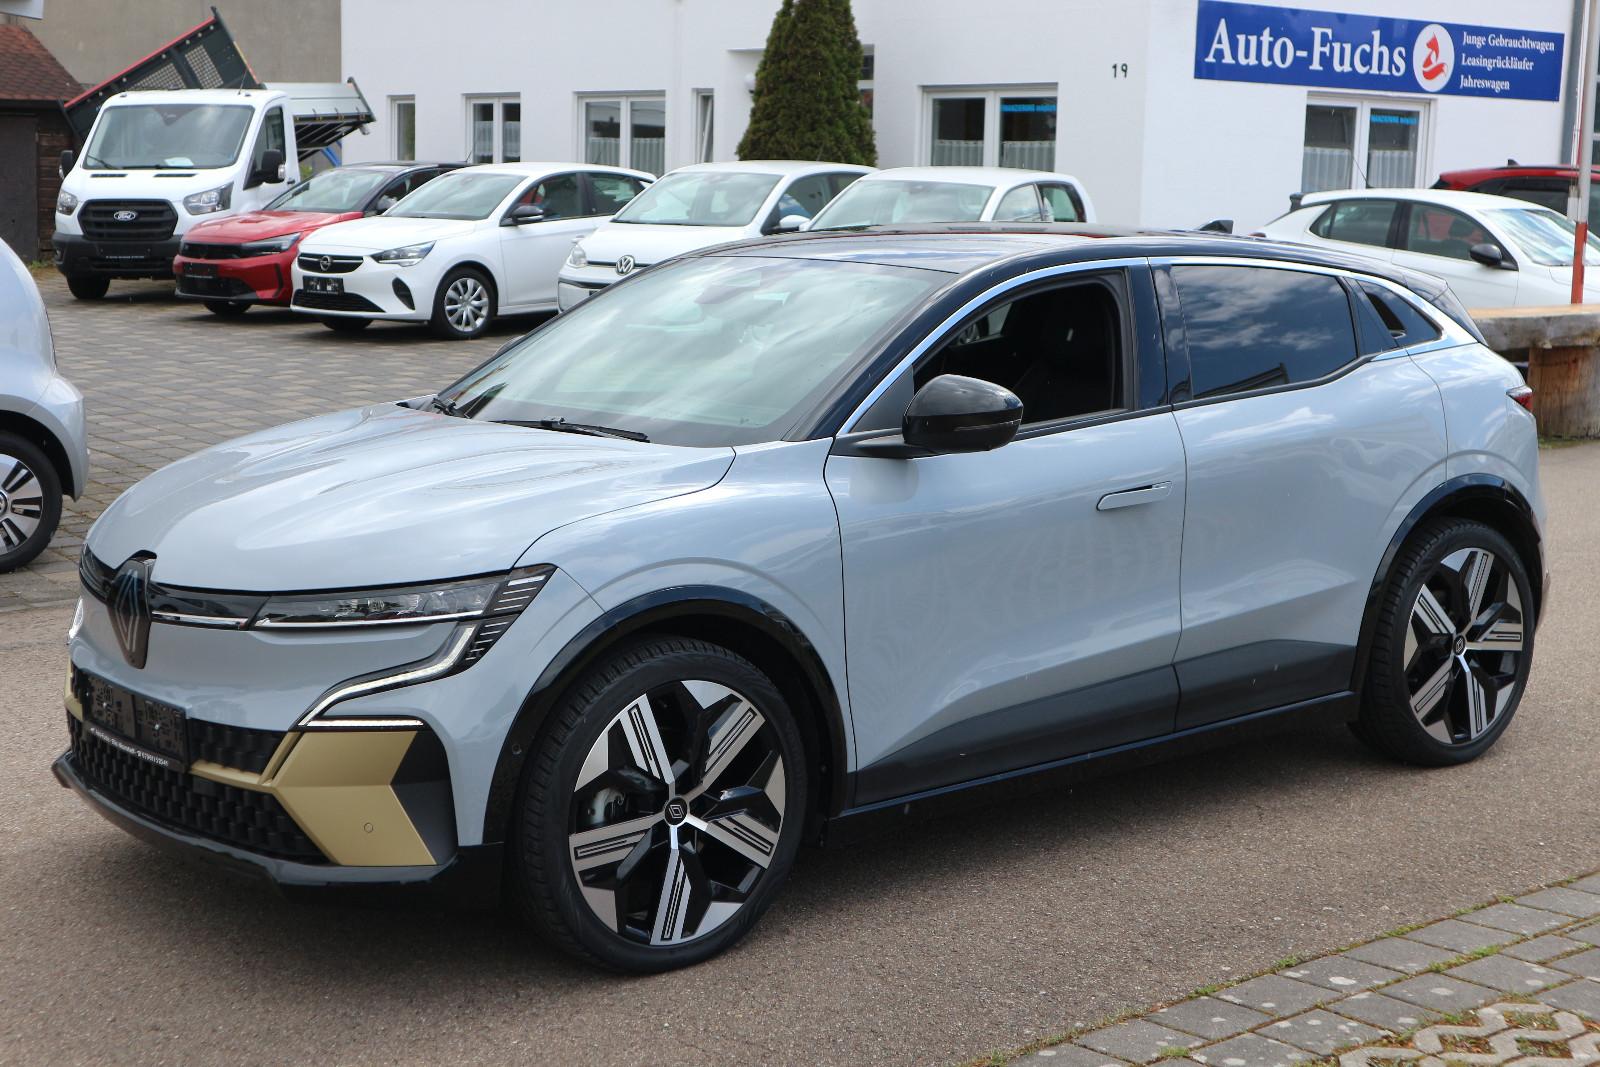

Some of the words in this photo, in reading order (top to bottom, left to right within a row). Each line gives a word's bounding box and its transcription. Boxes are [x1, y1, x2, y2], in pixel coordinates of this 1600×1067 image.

[1204, 17, 1407, 77] Auto-Fuchs
[1463, 31, 1487, 49] Junge
[1488, 33, 1555, 54] Gebrauchtwagen
[1112, 63, 1128, 79] 19
[1461, 53, 1534, 71] Leasingrückläufer
[1460, 74, 1510, 93] Jahreswagen
[616, 255, 634, 275] VW
